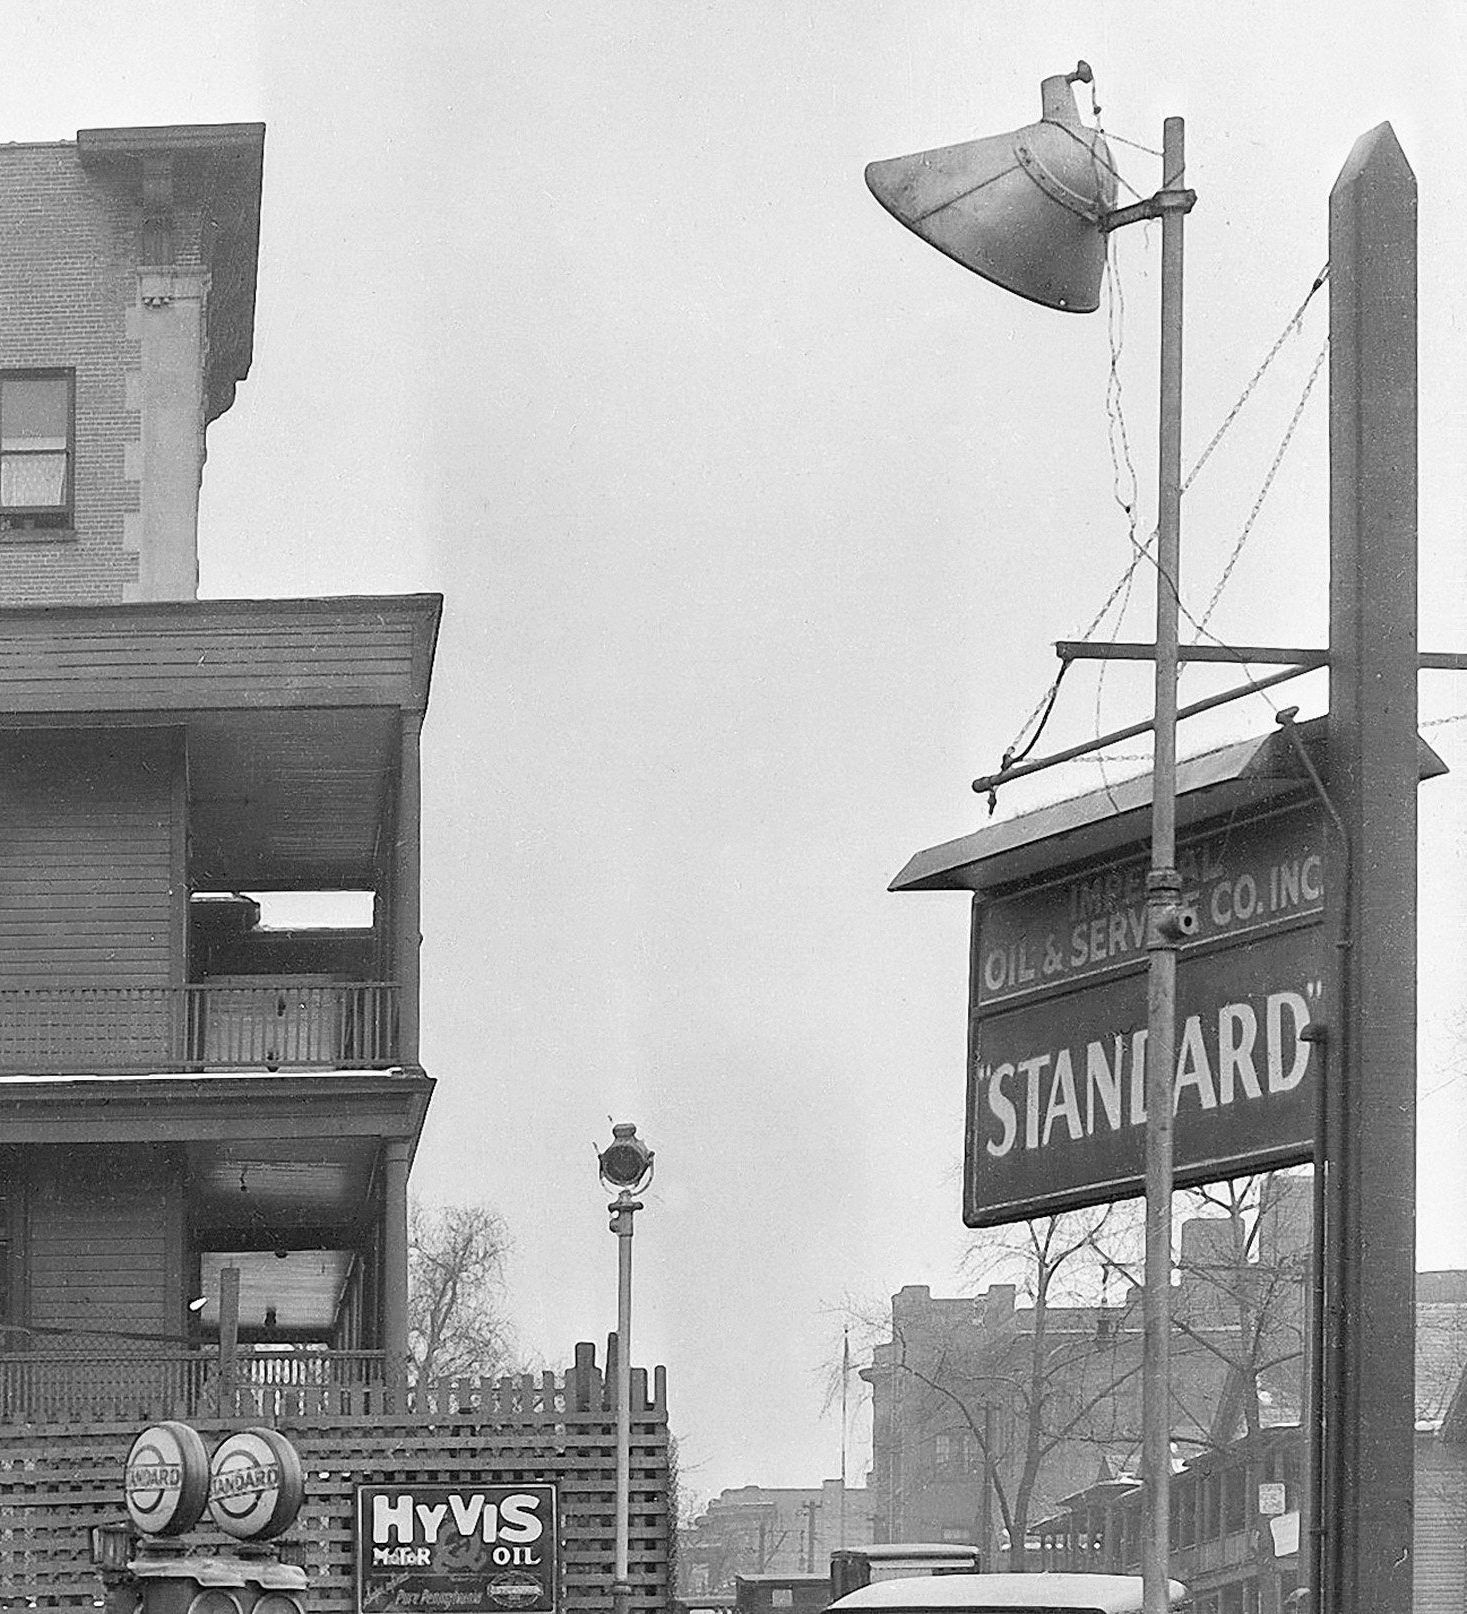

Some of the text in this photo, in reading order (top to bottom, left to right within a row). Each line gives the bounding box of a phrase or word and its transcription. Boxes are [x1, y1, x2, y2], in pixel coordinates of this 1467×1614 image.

[1070, 843, 1224, 918] IMPEAL
[984, 941, 1035, 990] OIL
[1043, 933, 1063, 975] &
[1071, 889, 1200, 968] SERV
[1211, 873, 1264, 926] CO.
[212, 1468, 279, 1497] ANDARD
[373, 1494, 543, 1544] HYVIS
[373, 1546, 542, 1566] MOTOR OIL
